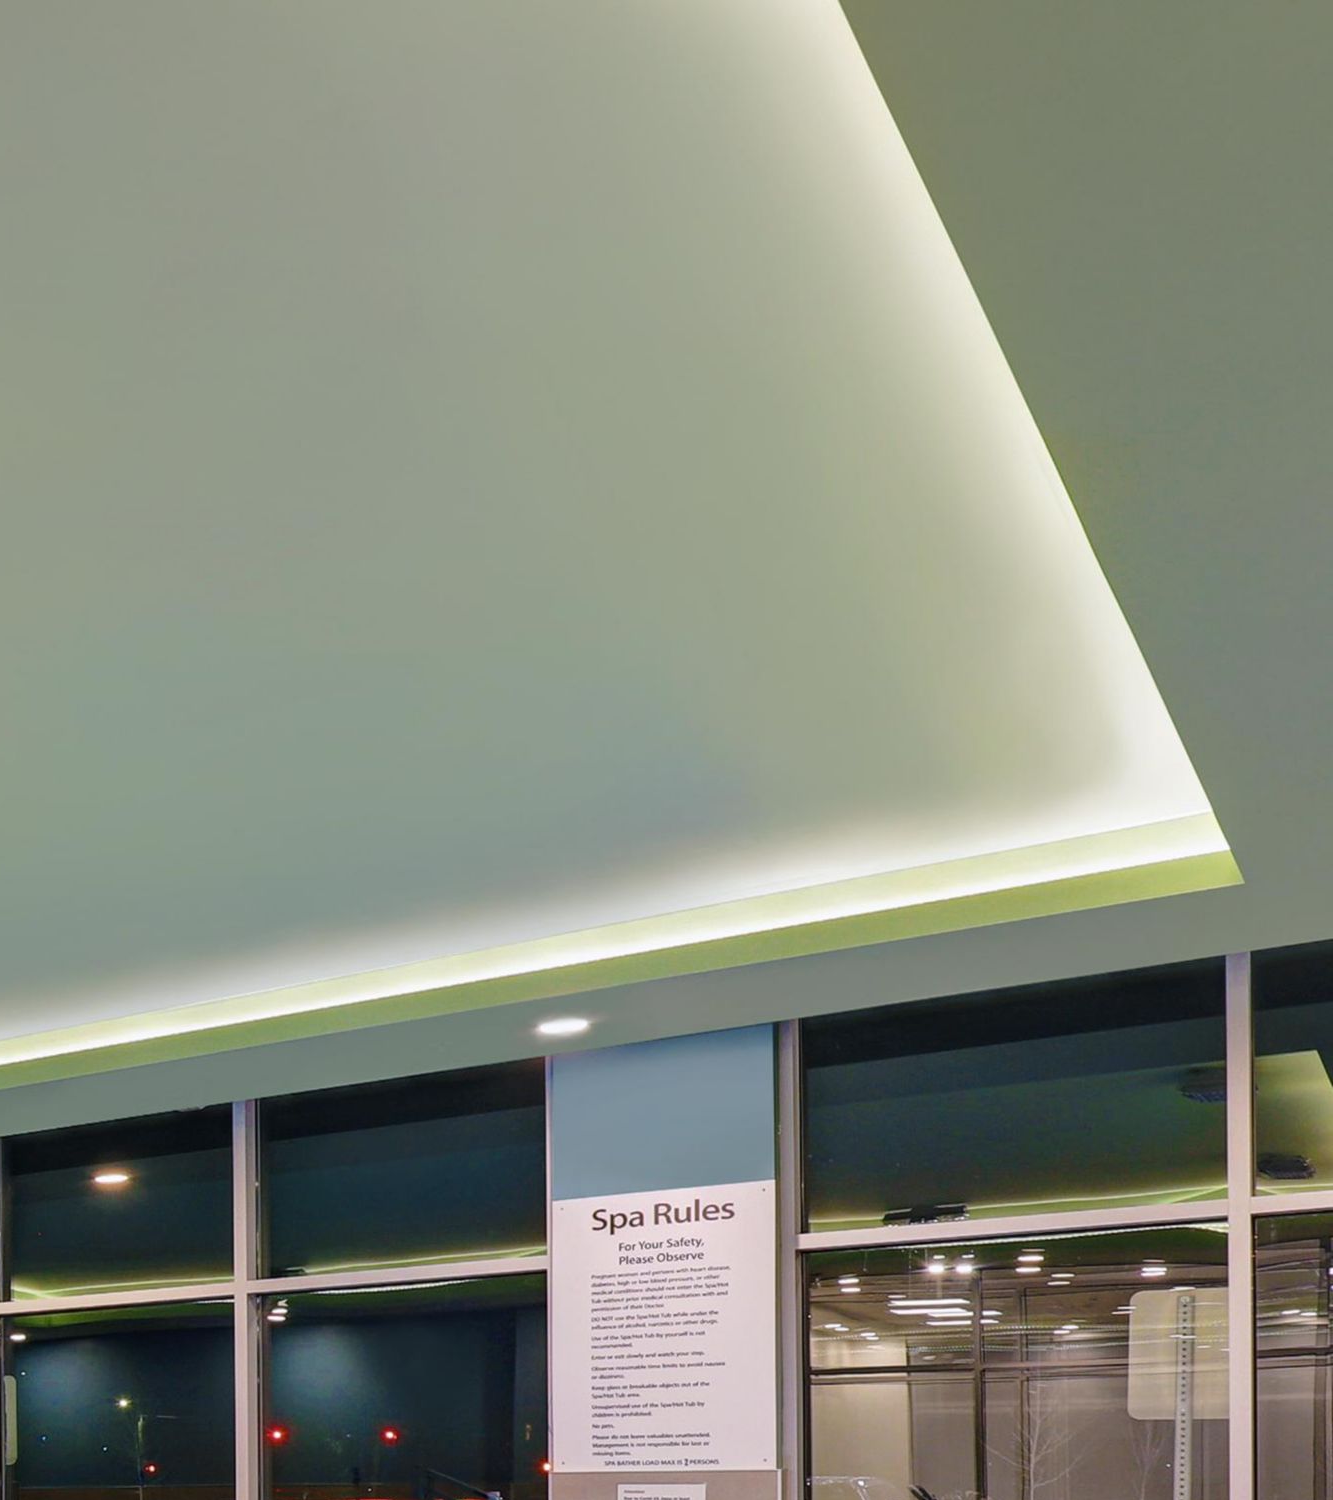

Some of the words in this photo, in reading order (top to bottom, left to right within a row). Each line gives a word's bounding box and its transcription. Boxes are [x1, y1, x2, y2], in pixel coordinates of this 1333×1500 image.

[592, 1208, 645, 1236] Spa
[653, 1198, 736, 1226] Rules
[619, 1242, 636, 1253] For
[639, 1240, 664, 1251] Your
[667, 1236, 705, 1250] Safety,
[619, 1253, 654, 1266] Please
[657, 1250, 704, 1263] Observe
